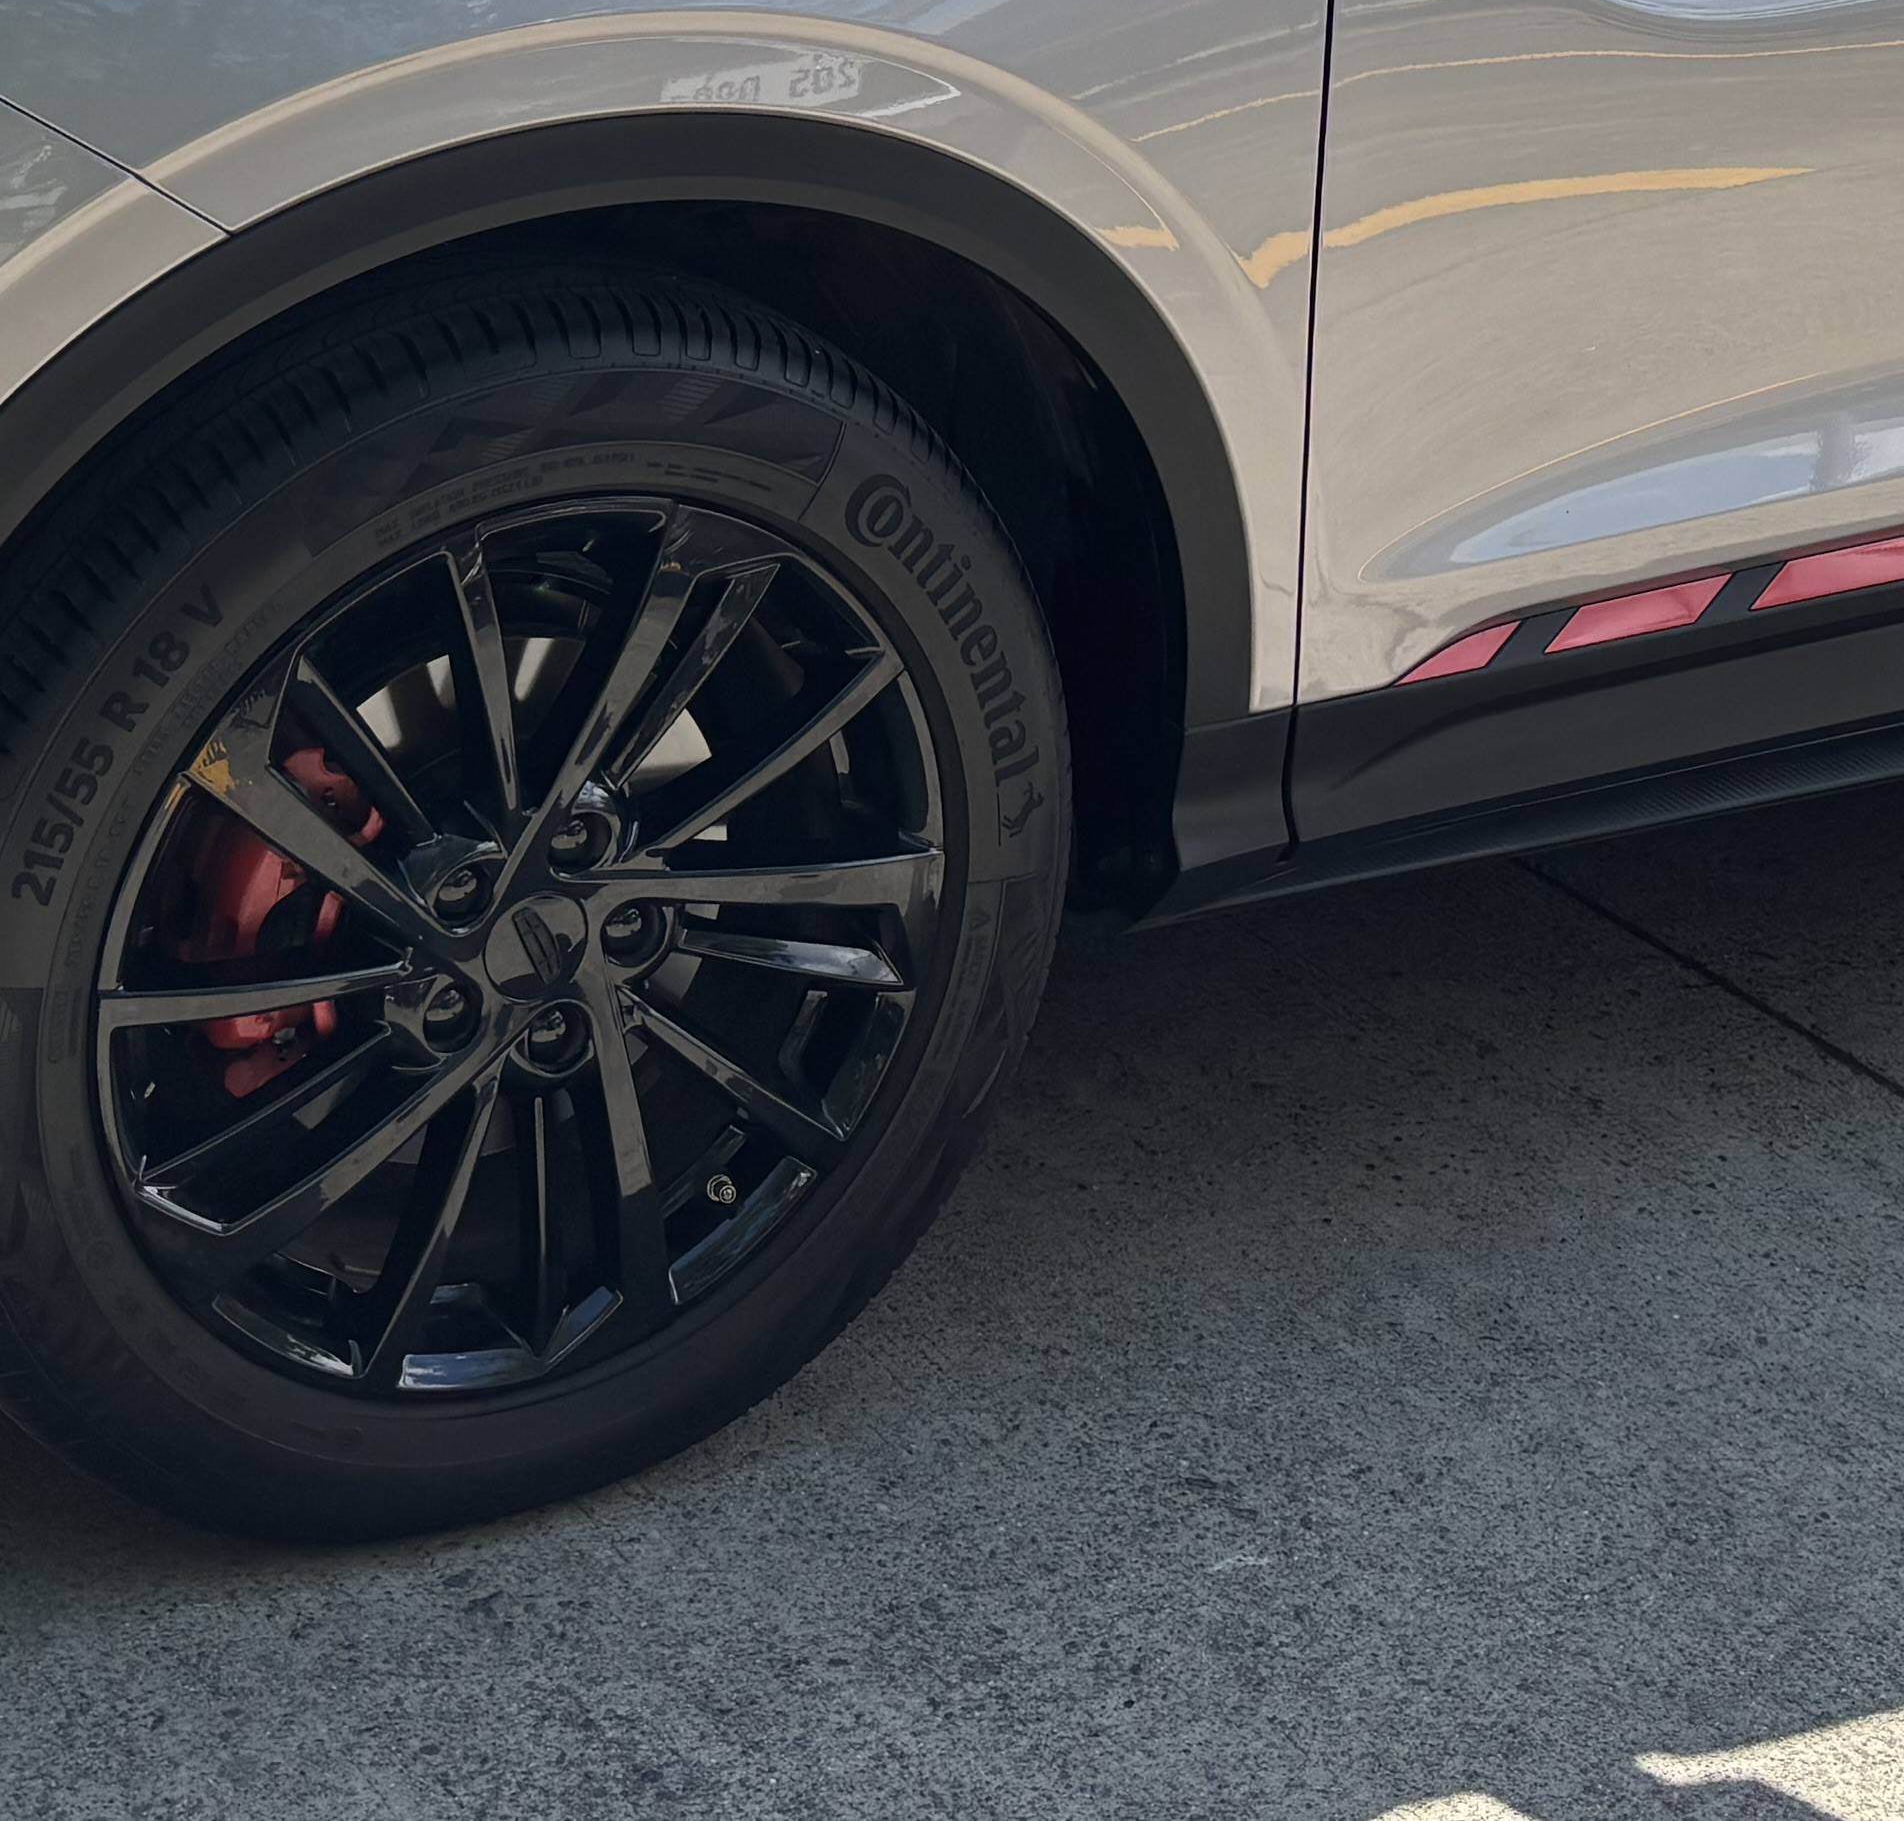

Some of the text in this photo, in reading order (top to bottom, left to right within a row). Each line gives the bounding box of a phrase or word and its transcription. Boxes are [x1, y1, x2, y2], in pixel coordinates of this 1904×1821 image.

[10, 736, 115, 907] 215/55
[98, 690, 150, 733] R
[132, 629, 191, 690] 18
[180, 584, 224, 628] V
[844, 472, 1040, 787] Continental
